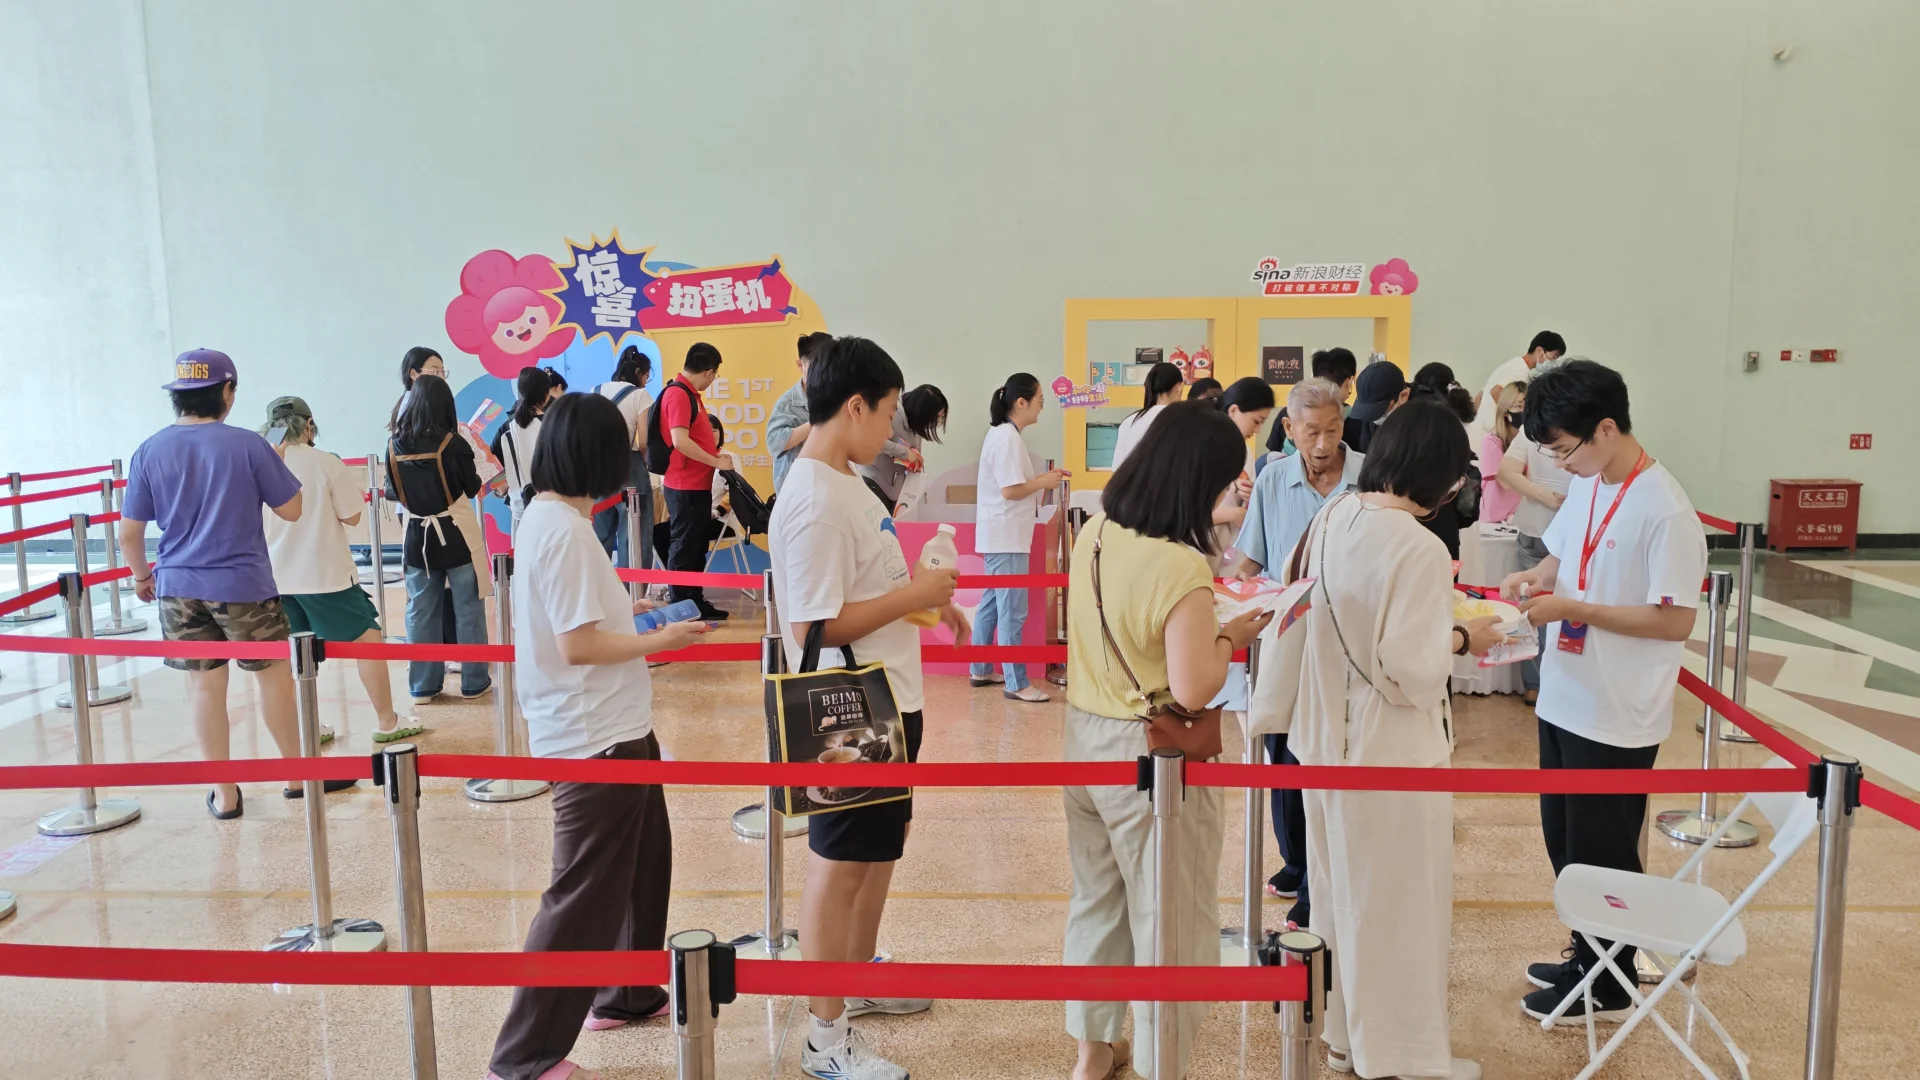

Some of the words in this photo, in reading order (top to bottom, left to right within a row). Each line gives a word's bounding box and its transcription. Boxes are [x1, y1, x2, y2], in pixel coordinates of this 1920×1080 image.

[1253, 266, 1290, 284] sina
[1293, 265, 1363, 280] 新浪财经
[573, 249, 638, 328] 惊喜
[666, 276, 772, 318] 扭蛋机
[1272, 283, 1352, 292] 打破信息不对称
[738, 377, 774, 399] 1ST
[1828, 524, 1843, 534] 119
[827, 703, 864, 715] COFFEE
